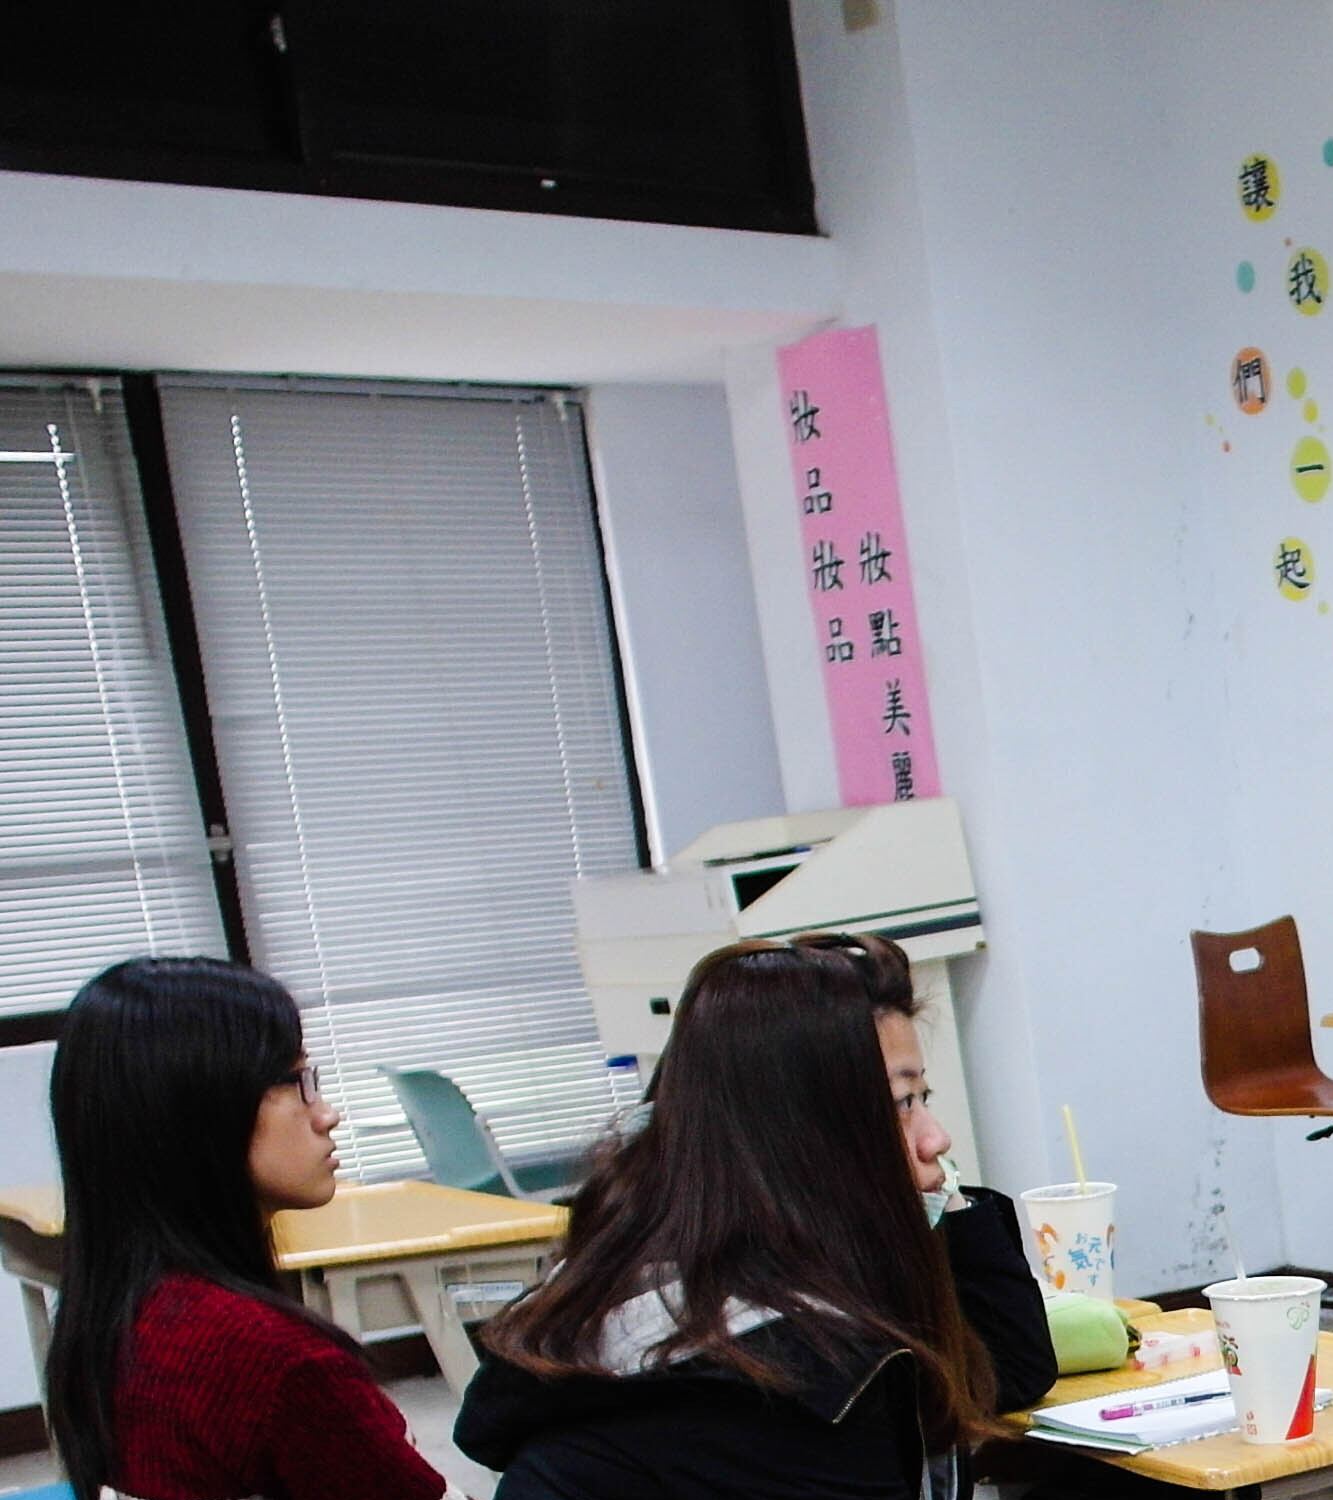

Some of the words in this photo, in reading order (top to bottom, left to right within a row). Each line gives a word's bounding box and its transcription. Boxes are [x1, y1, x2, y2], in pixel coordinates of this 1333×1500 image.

[1238, 160, 1274, 213] 讓
[1288, 252, 1324, 305] 我
[1231, 357, 1270, 405] 們
[1274, 543, 1311, 591] 起
